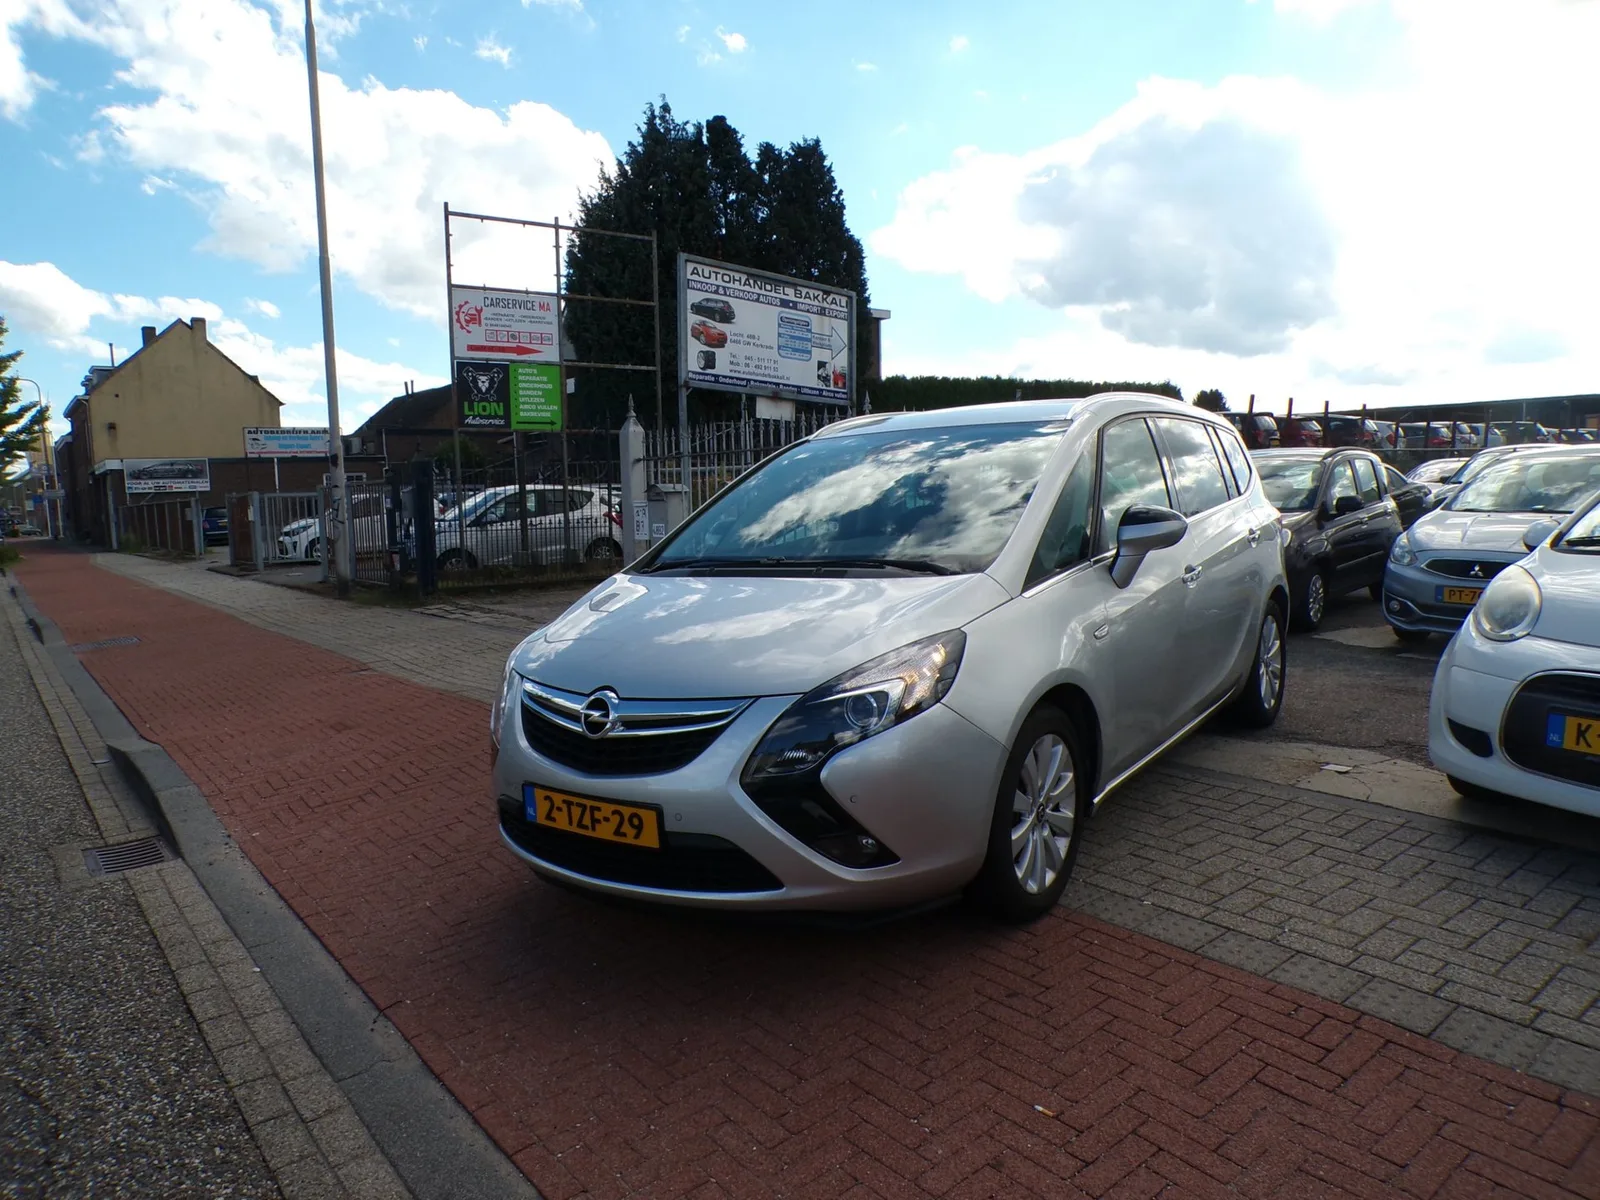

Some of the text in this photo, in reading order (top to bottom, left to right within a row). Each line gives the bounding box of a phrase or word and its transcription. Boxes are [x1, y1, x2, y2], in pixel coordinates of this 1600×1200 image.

[690, 266, 848, 309] AUTOHANDEL BAKKALI
[483, 296, 551, 312] CARSERVICE MA
[688, 280, 848, 320] INKOOP & VERKOOP AUTOS IMPORT EXPORT
[688, 371, 715, 382] Reparatie
[718, 376, 747, 386] Onderhoud
[463, 401, 504, 416] LION
[464, 415, 506, 426] Autoservice
[543, 795, 644, 840] 2-TZF-29
